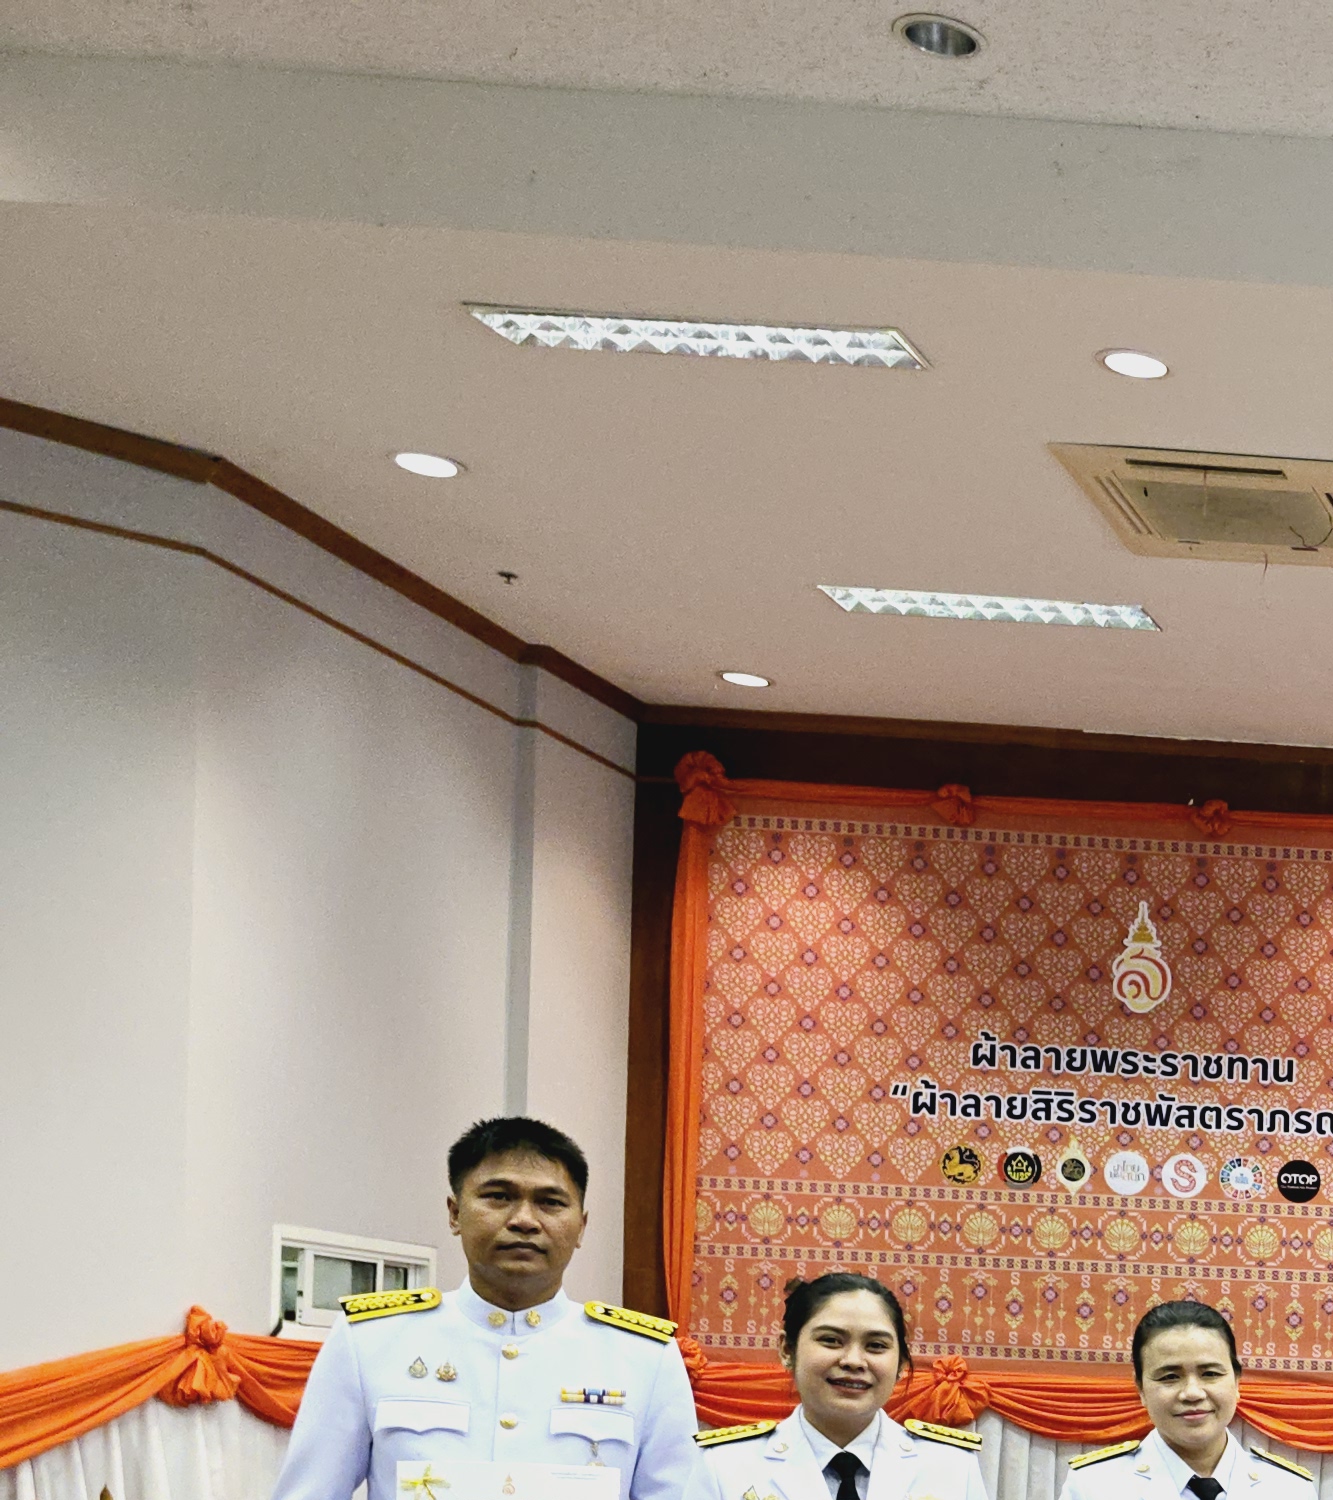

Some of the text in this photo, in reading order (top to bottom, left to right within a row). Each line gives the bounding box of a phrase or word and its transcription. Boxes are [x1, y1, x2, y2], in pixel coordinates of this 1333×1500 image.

[971, 1031, 1294, 1082] ผ้าลายพระราชทาน
[1280, 1172, 1318, 1185] OTOP
